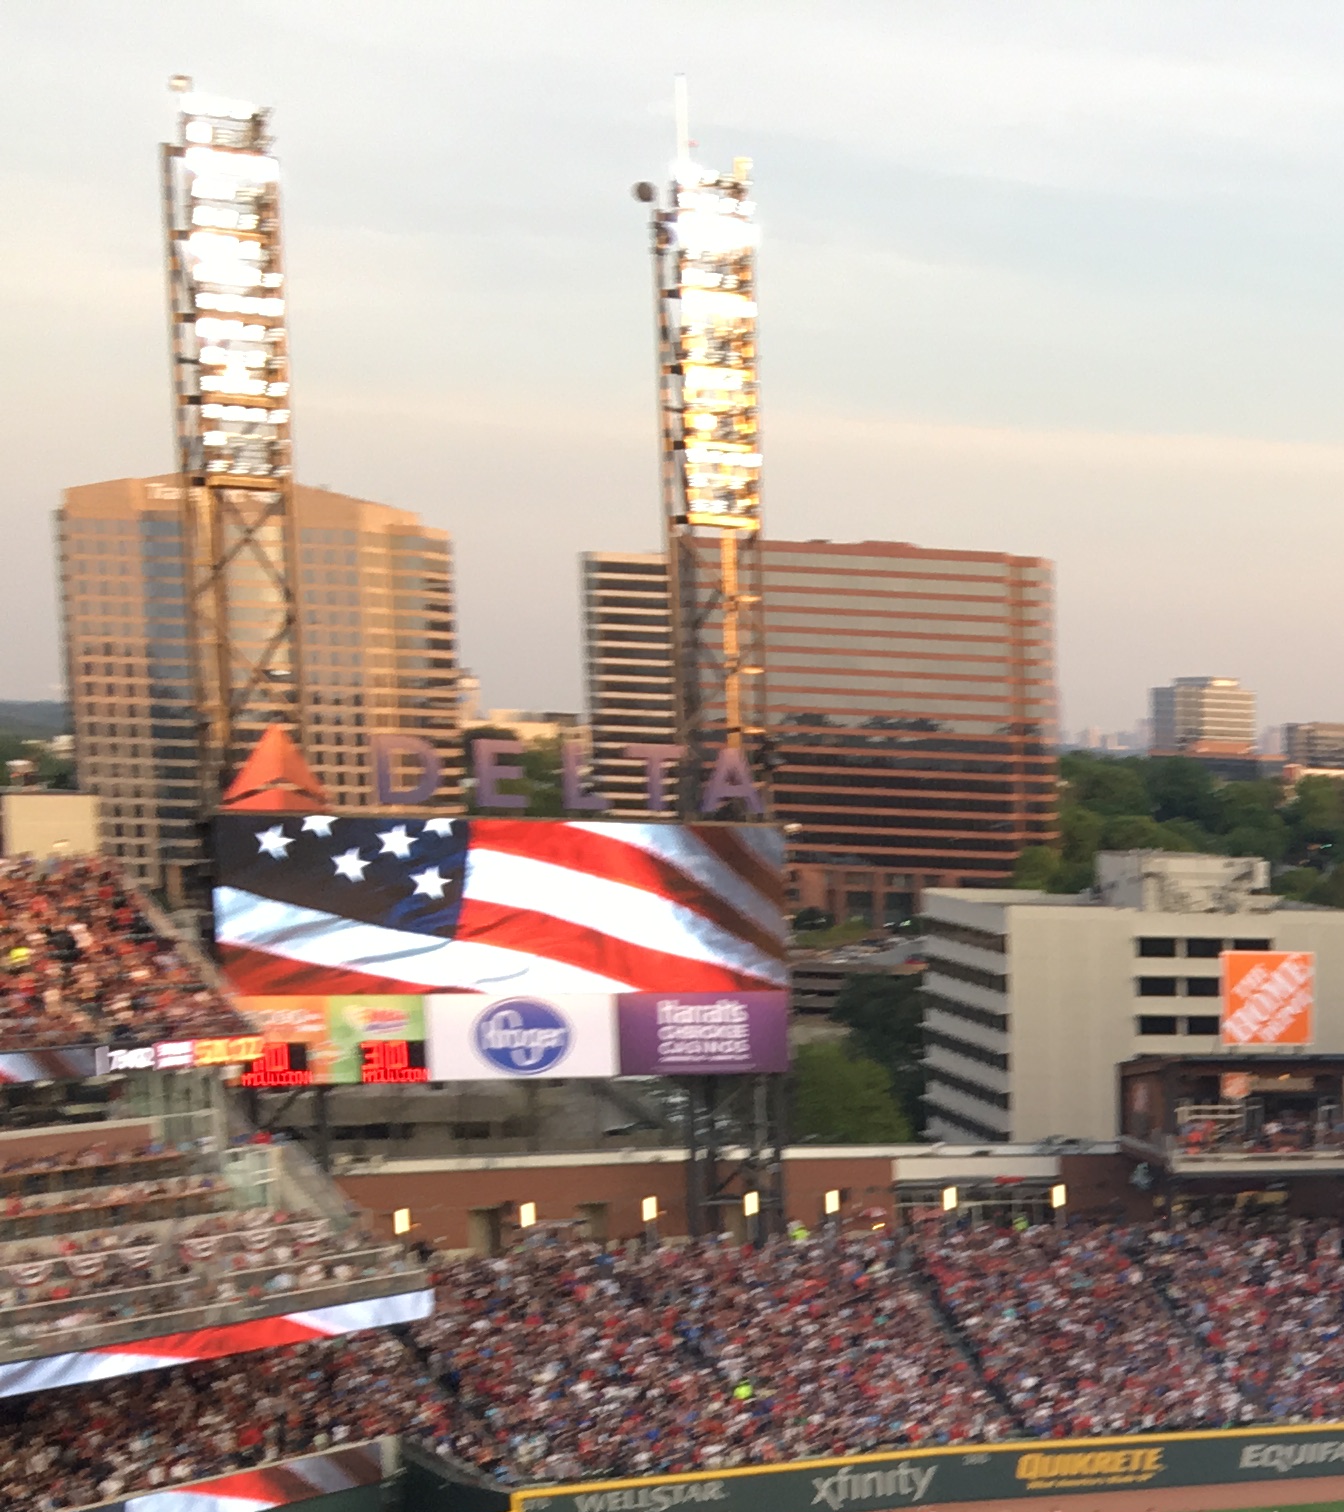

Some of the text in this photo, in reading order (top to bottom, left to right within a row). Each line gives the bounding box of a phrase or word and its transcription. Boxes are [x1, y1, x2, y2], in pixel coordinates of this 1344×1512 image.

[369, 735, 766, 814] DELTA
[1222, 953, 1315, 1043] HOME
[481, 1009, 568, 1066] Kroger
[362, 1069, 431, 1083] MILLION
[811, 1461, 938, 1510] xfinity
[1014, 1448, 1164, 1480] QUIKRETE
